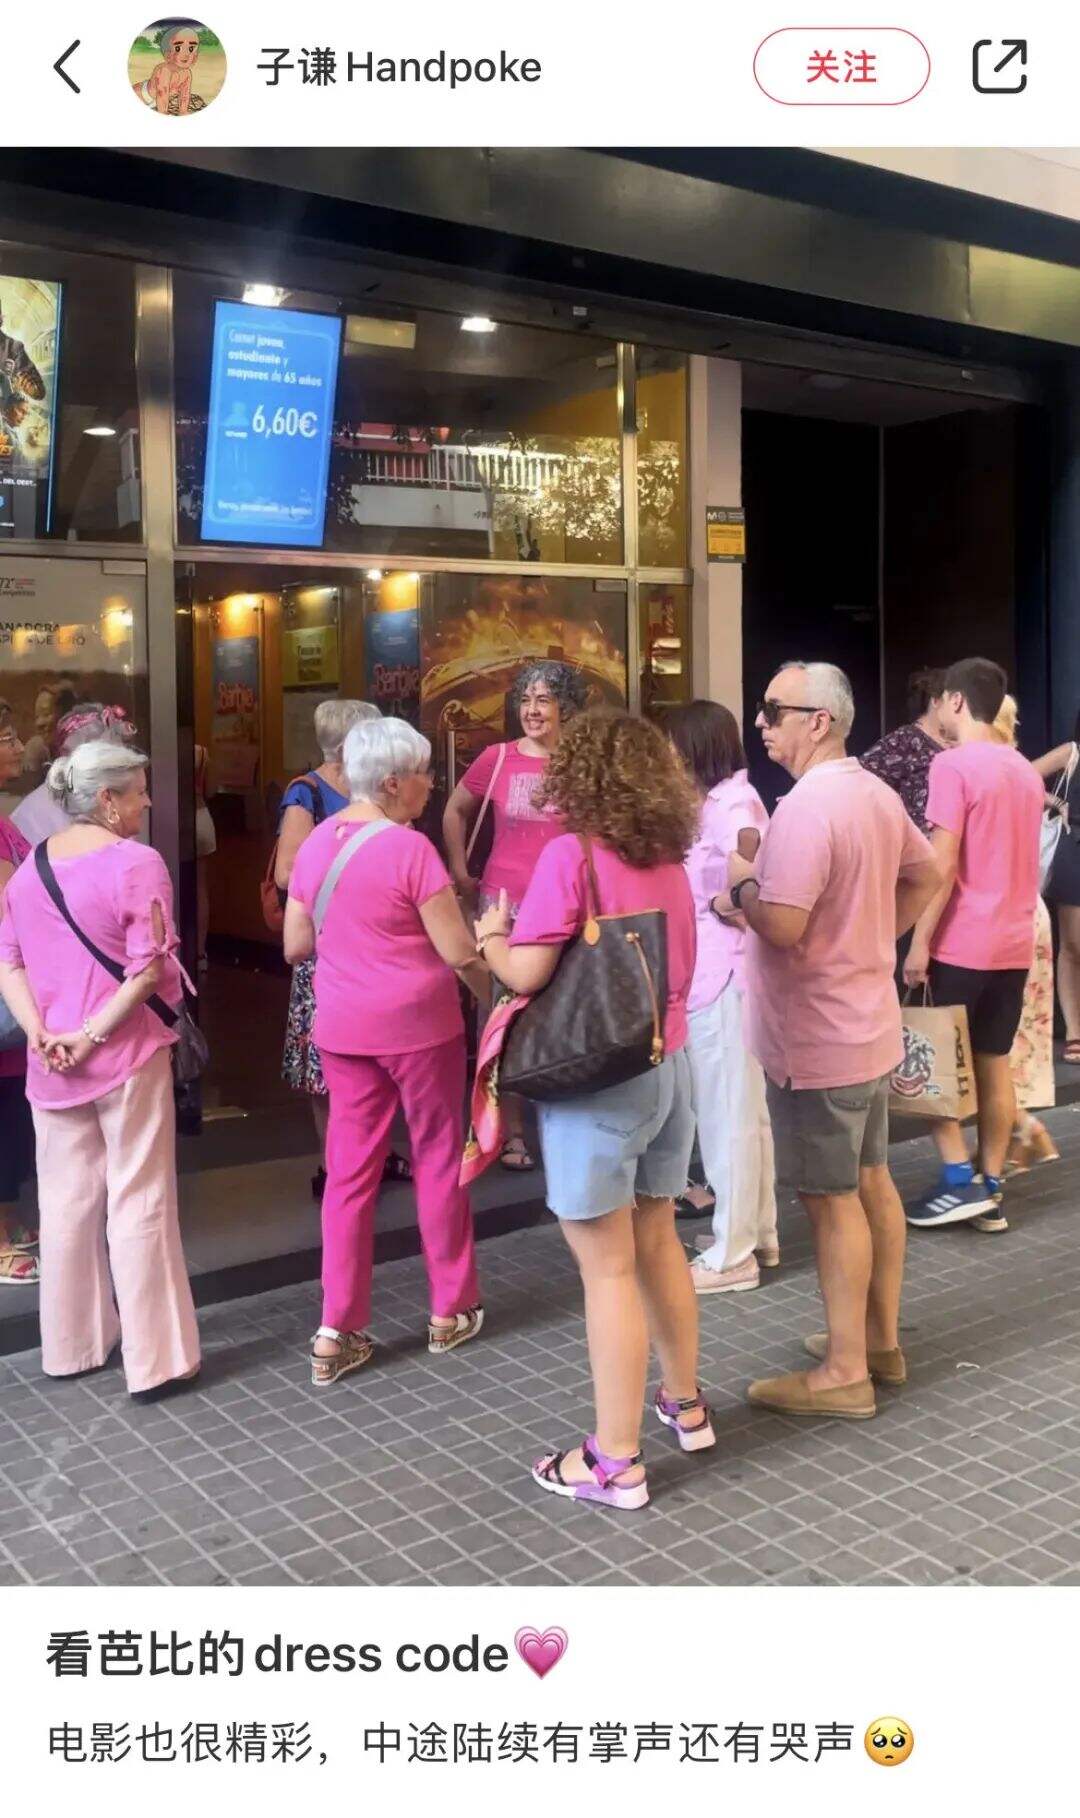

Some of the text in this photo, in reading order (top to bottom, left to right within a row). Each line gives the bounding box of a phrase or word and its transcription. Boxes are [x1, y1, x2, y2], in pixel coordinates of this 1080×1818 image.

[228, 350, 281, 365] estudiante
[227, 367, 269, 381] mayores
[284, 371, 297, 384] 65
[298, 374, 322, 387] años
[252, 404, 318, 438] 6,60€
